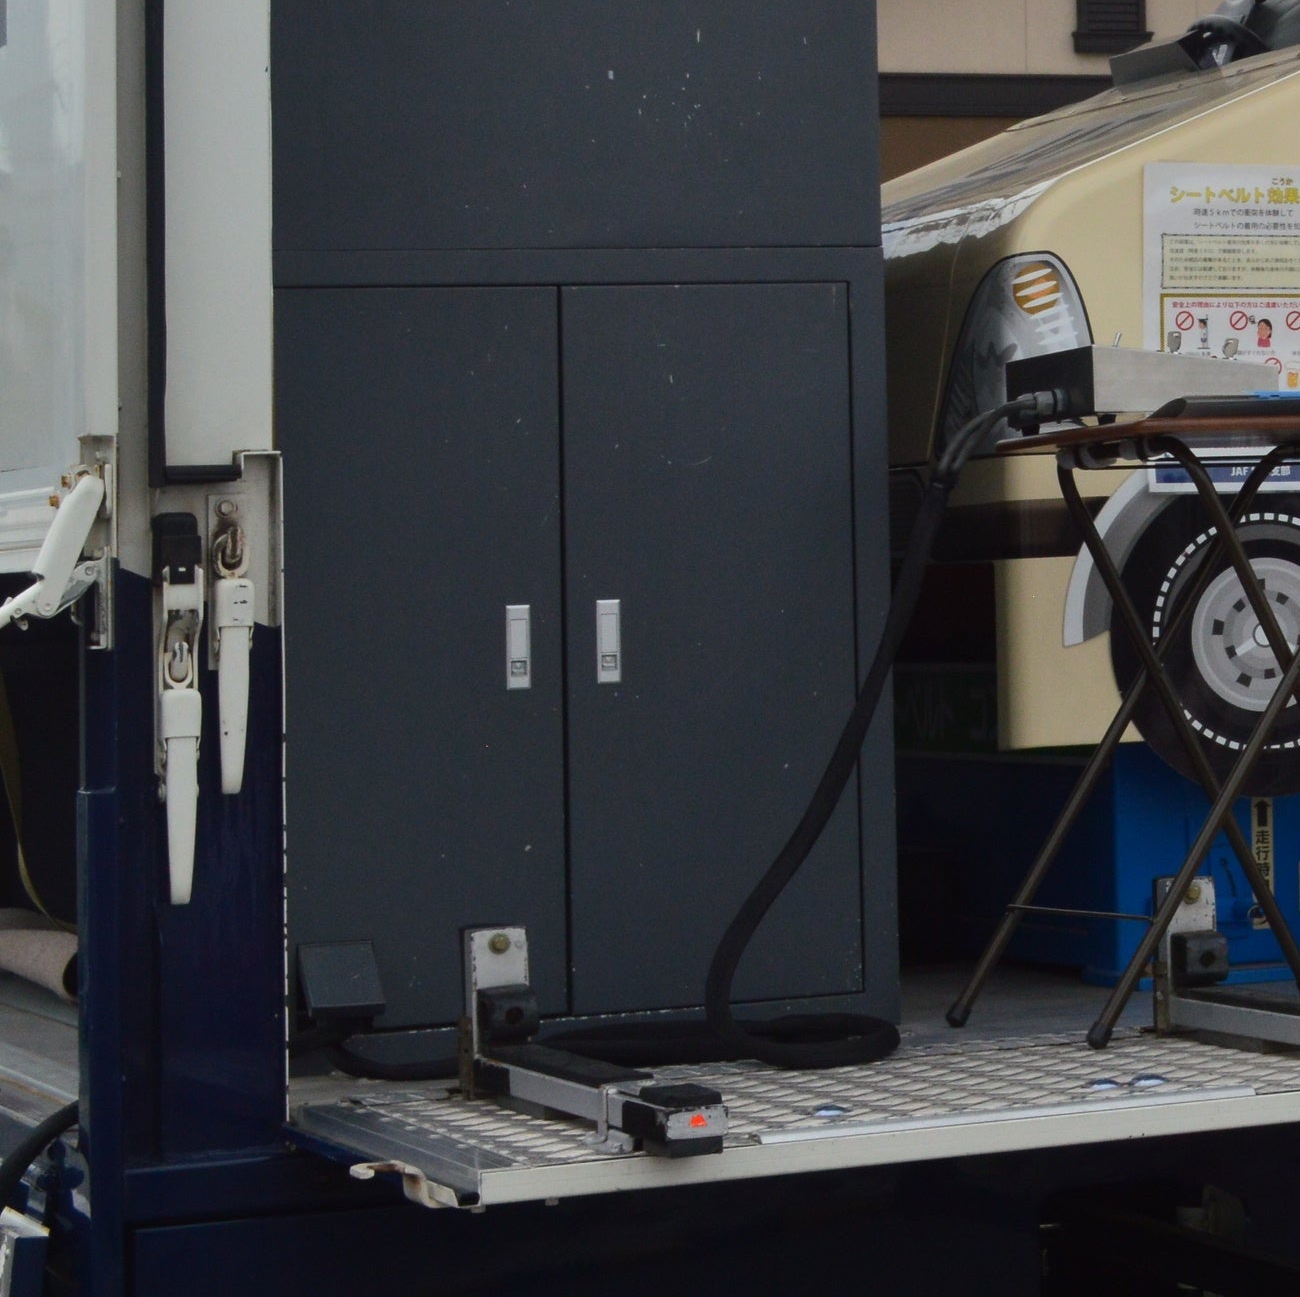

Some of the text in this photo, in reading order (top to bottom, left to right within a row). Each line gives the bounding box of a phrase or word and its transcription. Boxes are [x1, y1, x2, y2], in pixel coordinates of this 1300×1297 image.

[1271, 177, 1294, 186] こうか
[1230, 466, 1249, 478] JAF
